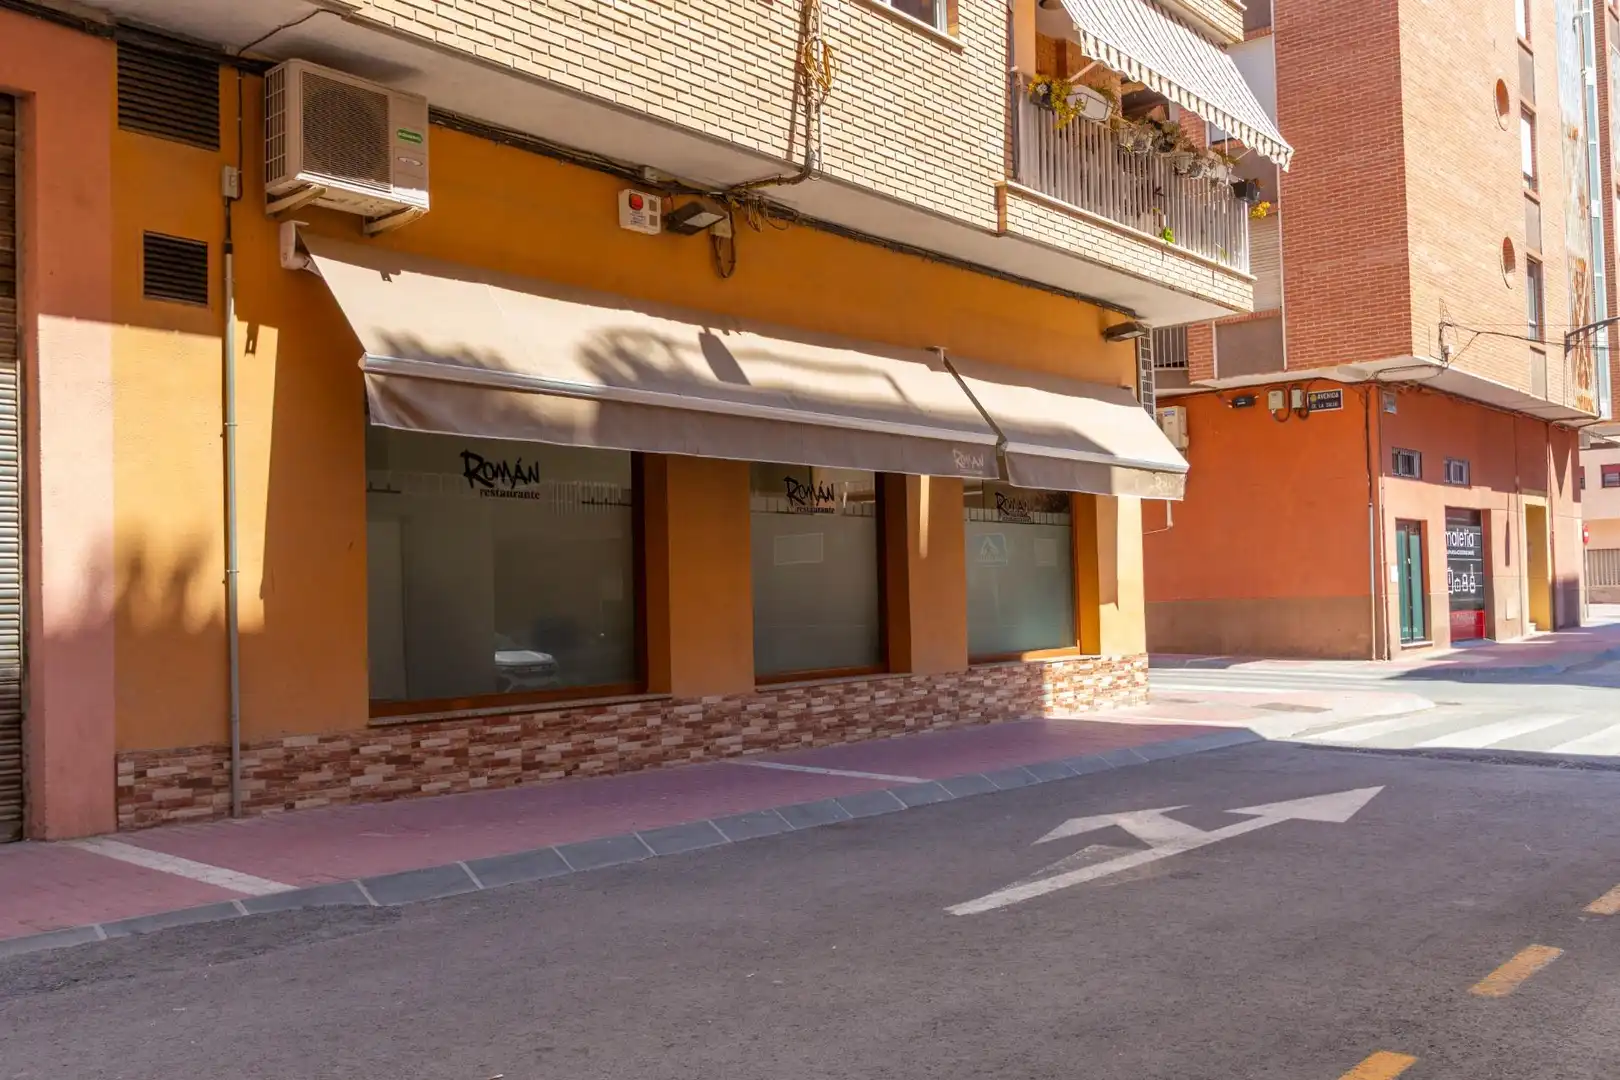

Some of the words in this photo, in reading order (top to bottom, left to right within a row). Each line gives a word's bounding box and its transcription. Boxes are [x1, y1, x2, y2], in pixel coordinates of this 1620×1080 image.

[1317, 391, 1339, 400] AVENIDA
[480, 488, 540, 500] restaurante
[796, 506, 835, 514] restaurante
